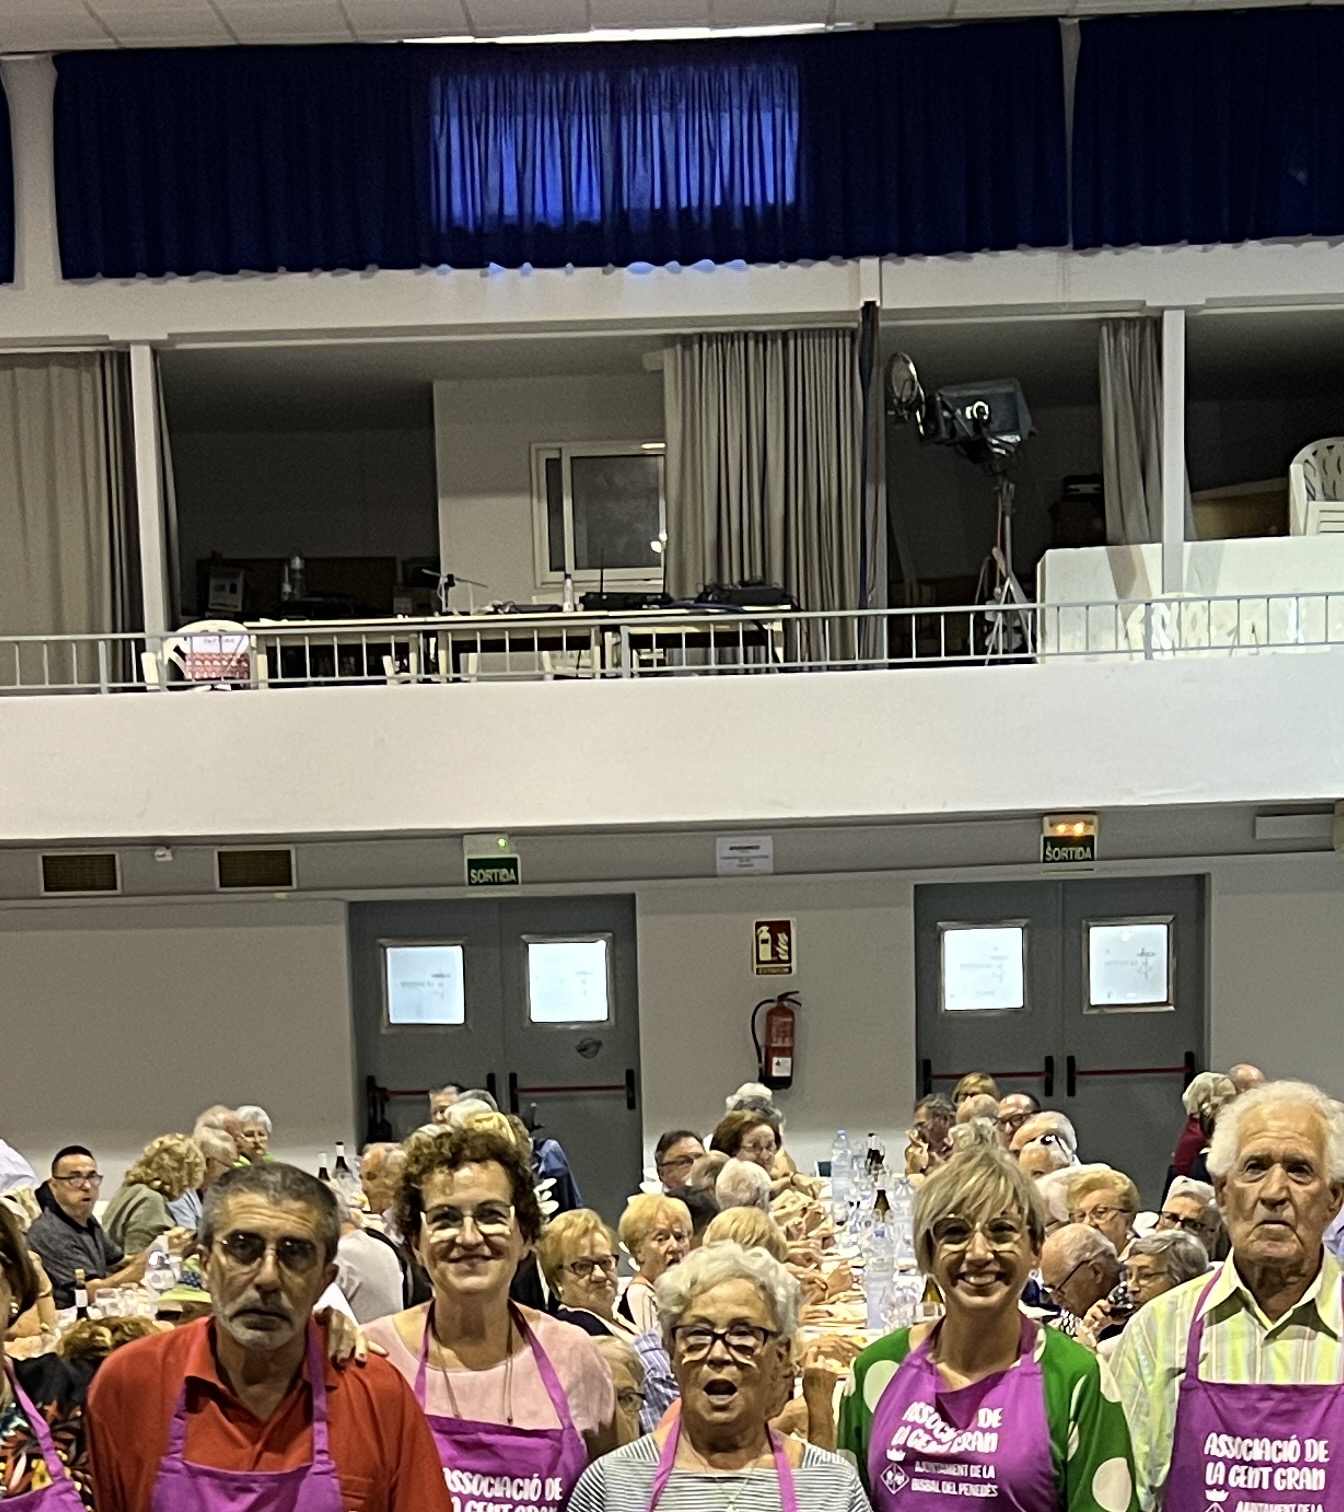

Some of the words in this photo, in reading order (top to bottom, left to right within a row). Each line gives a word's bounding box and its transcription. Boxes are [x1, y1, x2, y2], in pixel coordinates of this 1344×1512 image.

[1045, 846, 1093, 862] SORTIDA
[470, 868, 517, 884] SORTIDA
[977, 1407, 1004, 1428] DE
[1203, 1432, 1301, 1464] ASSOCIACIÓ
[1304, 1438, 1330, 1463] DE
[969, 1464, 982, 1478] DE
[982, 1465, 996, 1479] LA
[1205, 1461, 1226, 1486] LA
[1228, 1464, 1273, 1490] GENT
[1273, 1466, 1326, 1491] GRAN
[544, 1477, 563, 1501] DE
[941, 1480, 959, 1496] DEL
